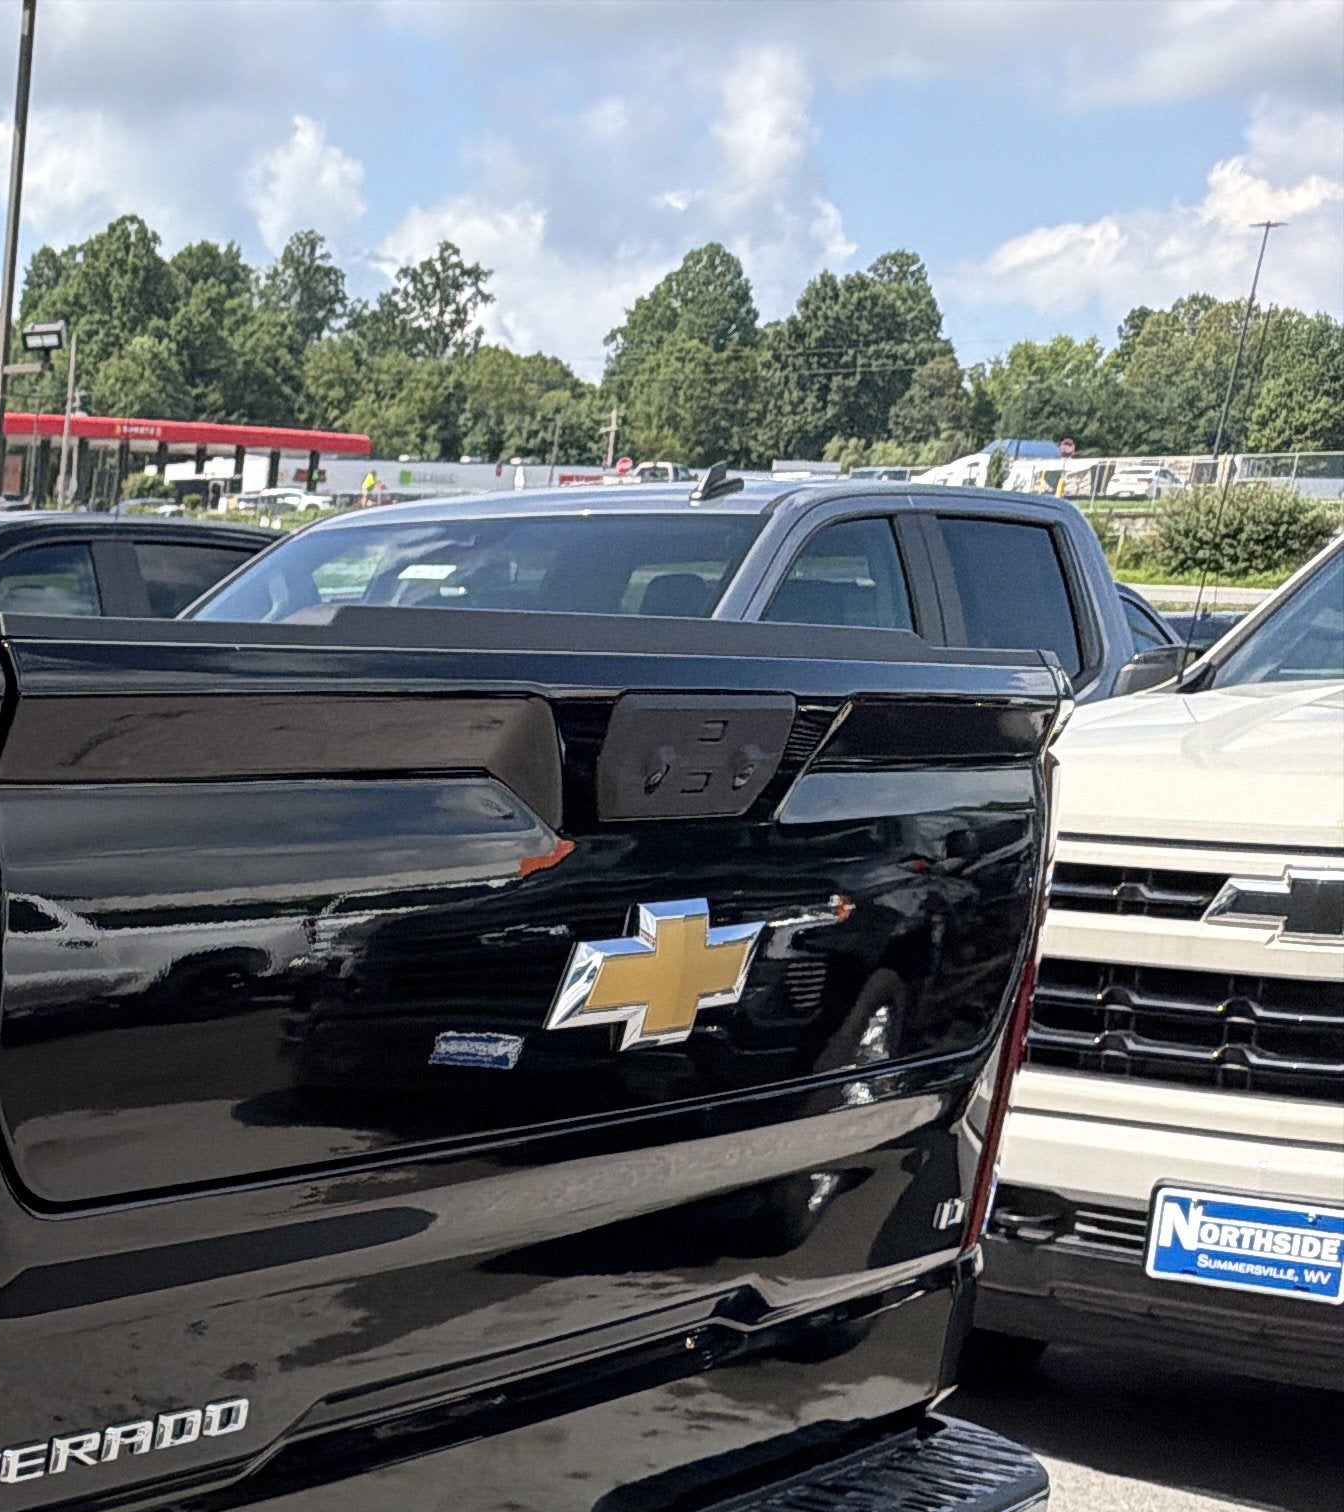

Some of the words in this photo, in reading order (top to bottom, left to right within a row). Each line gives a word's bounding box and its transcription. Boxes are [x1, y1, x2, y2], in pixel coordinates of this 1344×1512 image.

[1158, 1201, 1341, 1262] NORTHSIDE
[1196, 1253, 1299, 1282] SUMMERSVILLE,
[1303, 1268, 1332, 1285] WV
